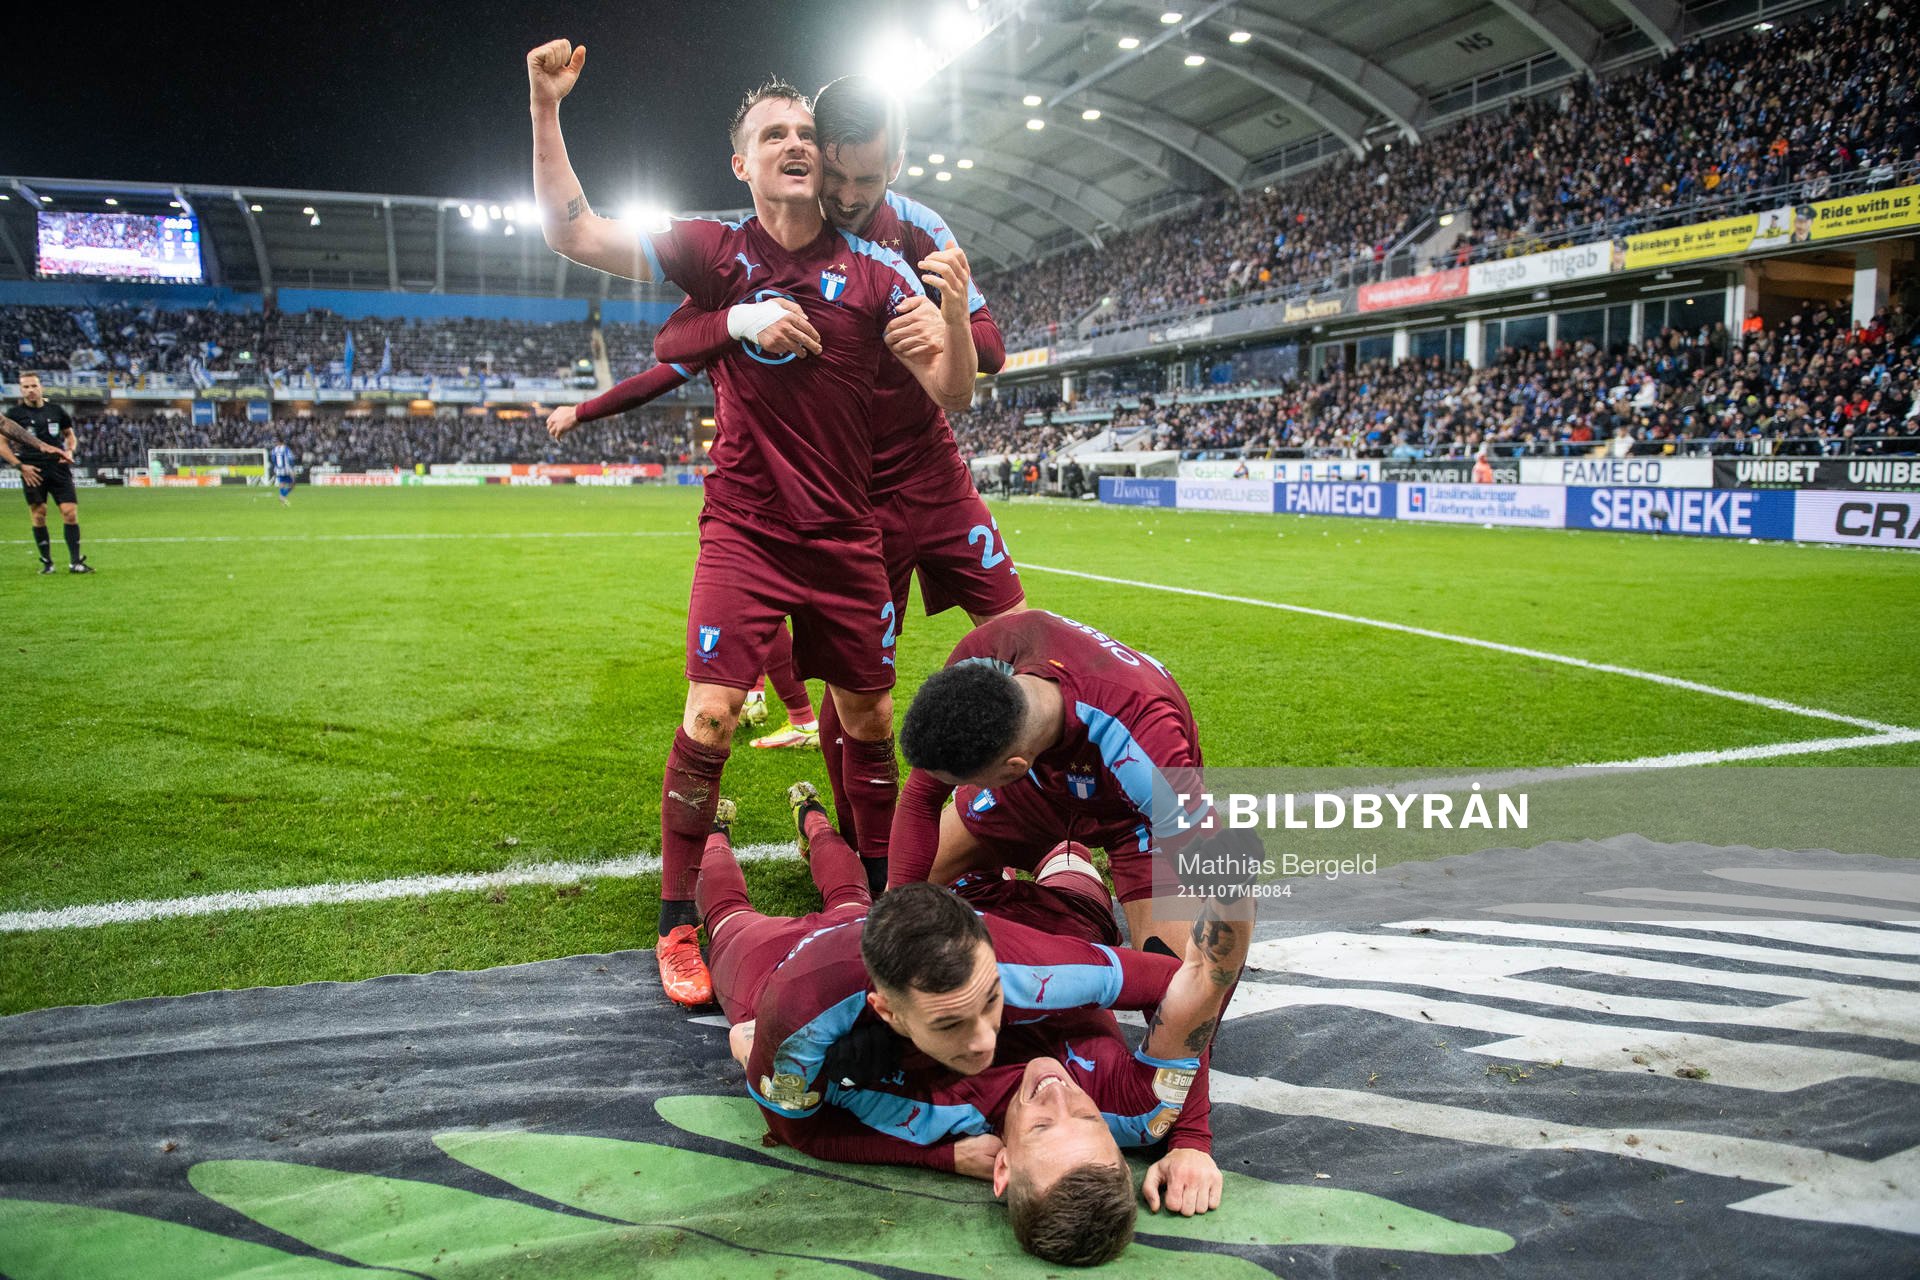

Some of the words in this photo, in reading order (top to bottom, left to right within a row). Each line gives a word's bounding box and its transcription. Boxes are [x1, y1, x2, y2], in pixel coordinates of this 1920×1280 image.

[1821, 205, 1853, 220] Ride
[1857, 197, 1890, 214] with
[1893, 195, 1911, 208] us
[1562, 461, 1661, 484] FAMECO
[1736, 461, 1820, 483] UNIBET
[1285, 484, 1382, 516] FAMECO
[1590, 488, 1753, 536] SERNEKE
